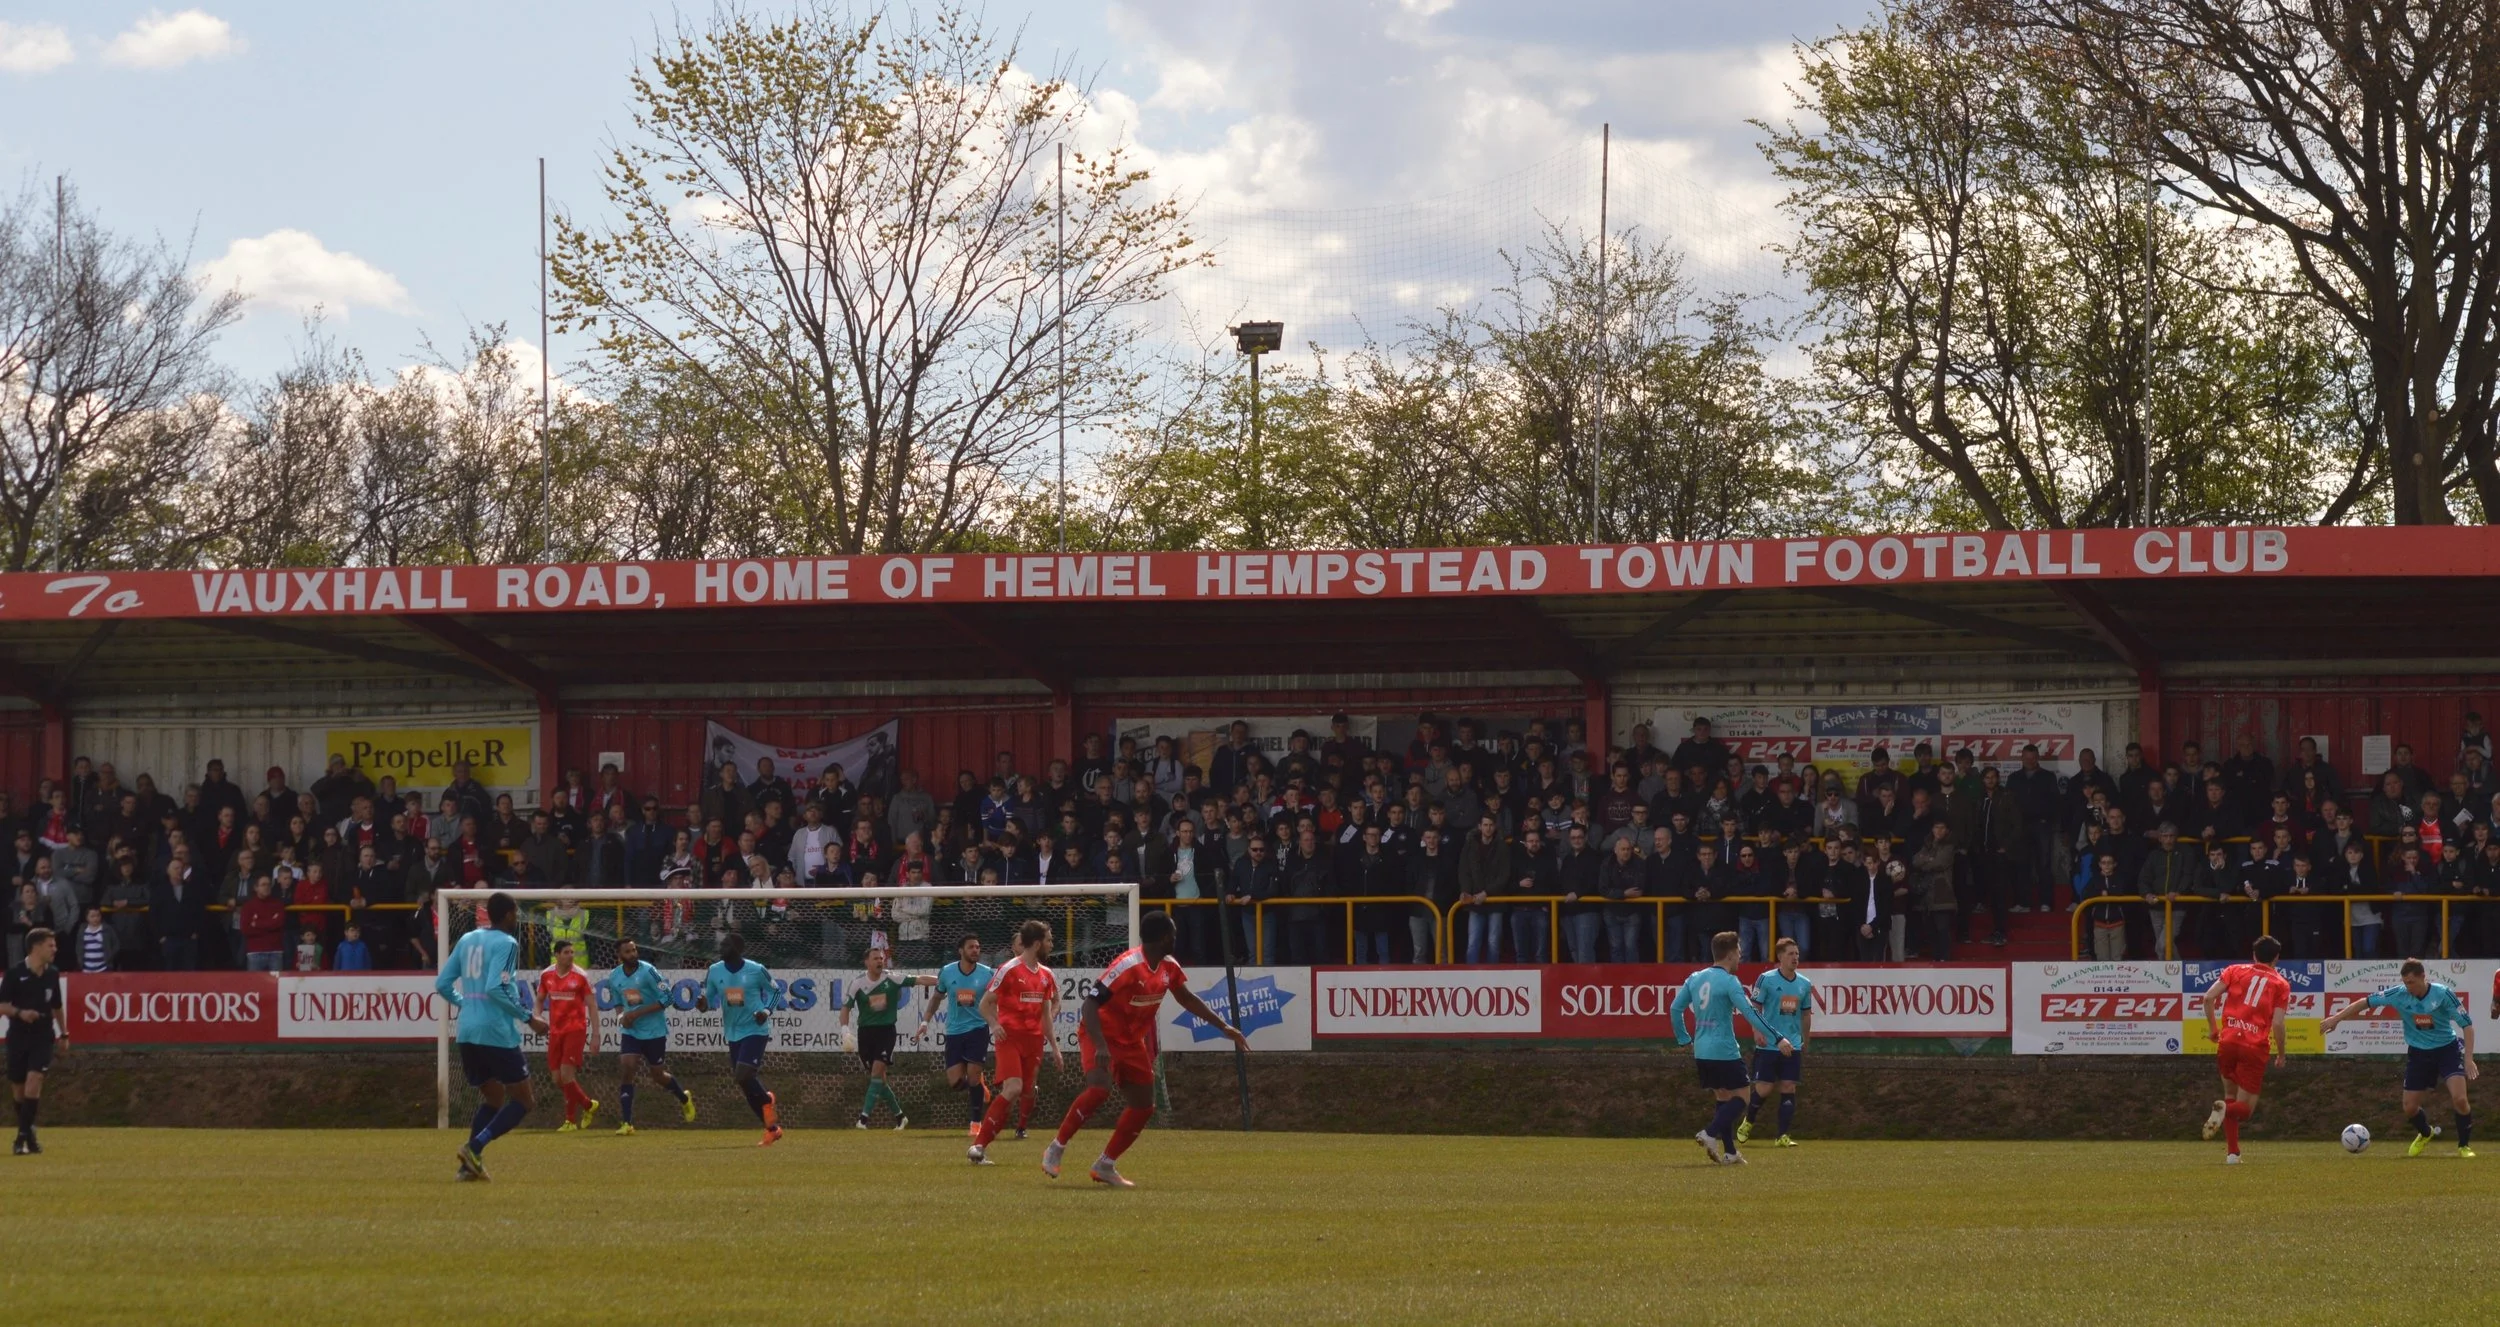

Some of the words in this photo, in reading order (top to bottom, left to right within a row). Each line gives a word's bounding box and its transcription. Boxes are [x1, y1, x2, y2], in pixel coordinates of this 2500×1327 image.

[45, 575, 144, 613] To
[191, 569, 468, 612] VAUXHALL
[496, 565, 666, 608] ROAD,
[695, 559, 849, 603] HOME
[879, 557, 954, 599] OF
[984, 555, 1166, 598] HEMEL
[1196, 549, 1547, 595] HEMPSTEAD
[1579, 543, 1754, 589] TOWN
[1785, 537, 2101, 583] FOOTBALL
[2133, 532, 2289, 575] CLUB
[1750, 709, 1772, 719] 247
[1821, 710, 1865, 731] ARENA
[1869, 708, 1889, 719] 24
[1895, 710, 1931, 731] TAXIS
[350, 739, 507, 778] PropelleR
[1748, 741, 1807, 759] 247
[1945, 739, 2003, 757] 247
[2051, 964, 2114, 990] MILLENNIUM
[2117, 965, 2141, 974] 247
[2143, 970, 2173, 989] TAXIS
[2334, 963, 2398, 988] MILLENNIUM
[1252, 986, 1272, 1002] FIT,
[1329, 987, 1530, 1017] UNDERWOODS
[1698, 981, 1711, 1010] 9
[1811, 985, 1995, 1015] NDERWOODS
[2243, 975, 2268, 1008] 11
[85, 992, 260, 1022] SOLICITORS
[1258, 999, 1279, 1014] FIT!
[2046, 998, 2107, 1018] 247
[2115, 998, 2179, 1018] 247
